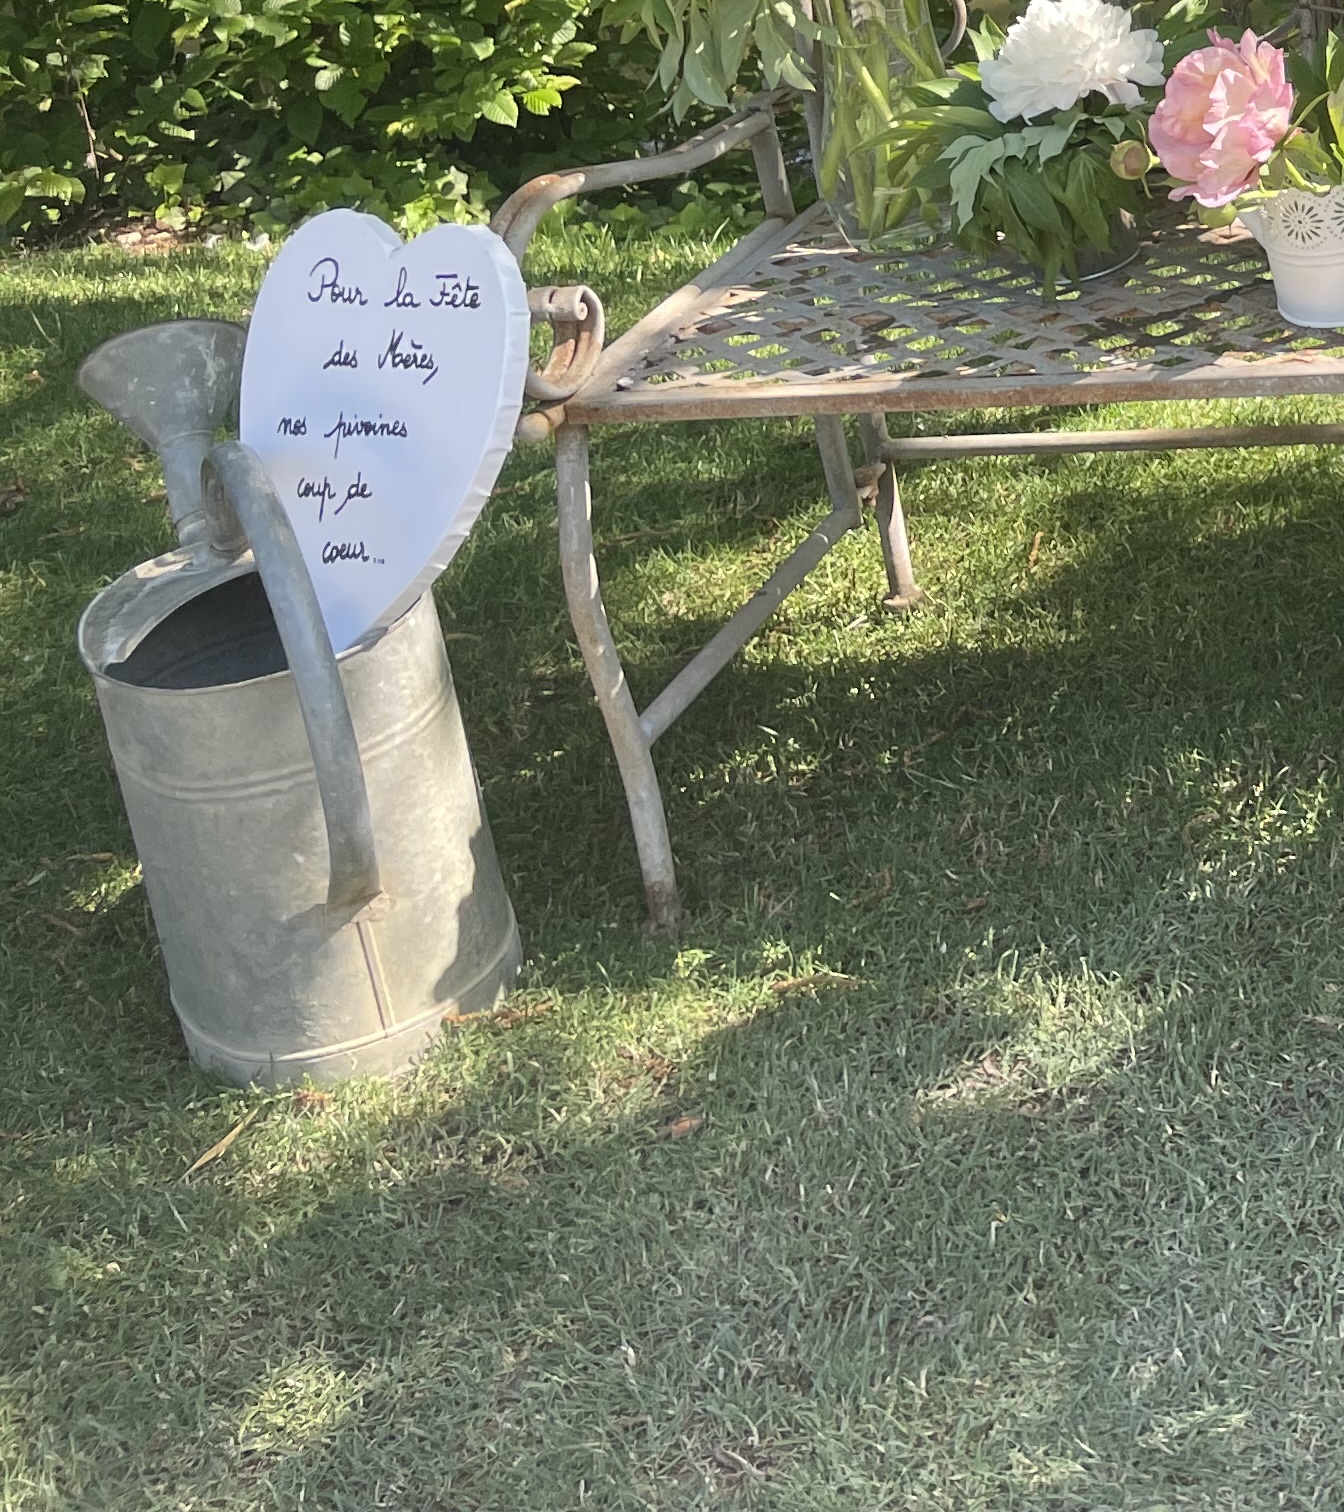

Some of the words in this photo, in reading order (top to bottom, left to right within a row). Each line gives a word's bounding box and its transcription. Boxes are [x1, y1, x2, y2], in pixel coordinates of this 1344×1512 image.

[307, 256, 369, 307] Pour
[383, 265, 422, 309] la
[428, 273, 482, 310] Fête
[322, 338, 359, 370] des
[276, 415, 308, 437] nos
[323, 410, 408, 460] pivoines
[296, 474, 340, 524] coup
[329, 470, 374, 516] de
